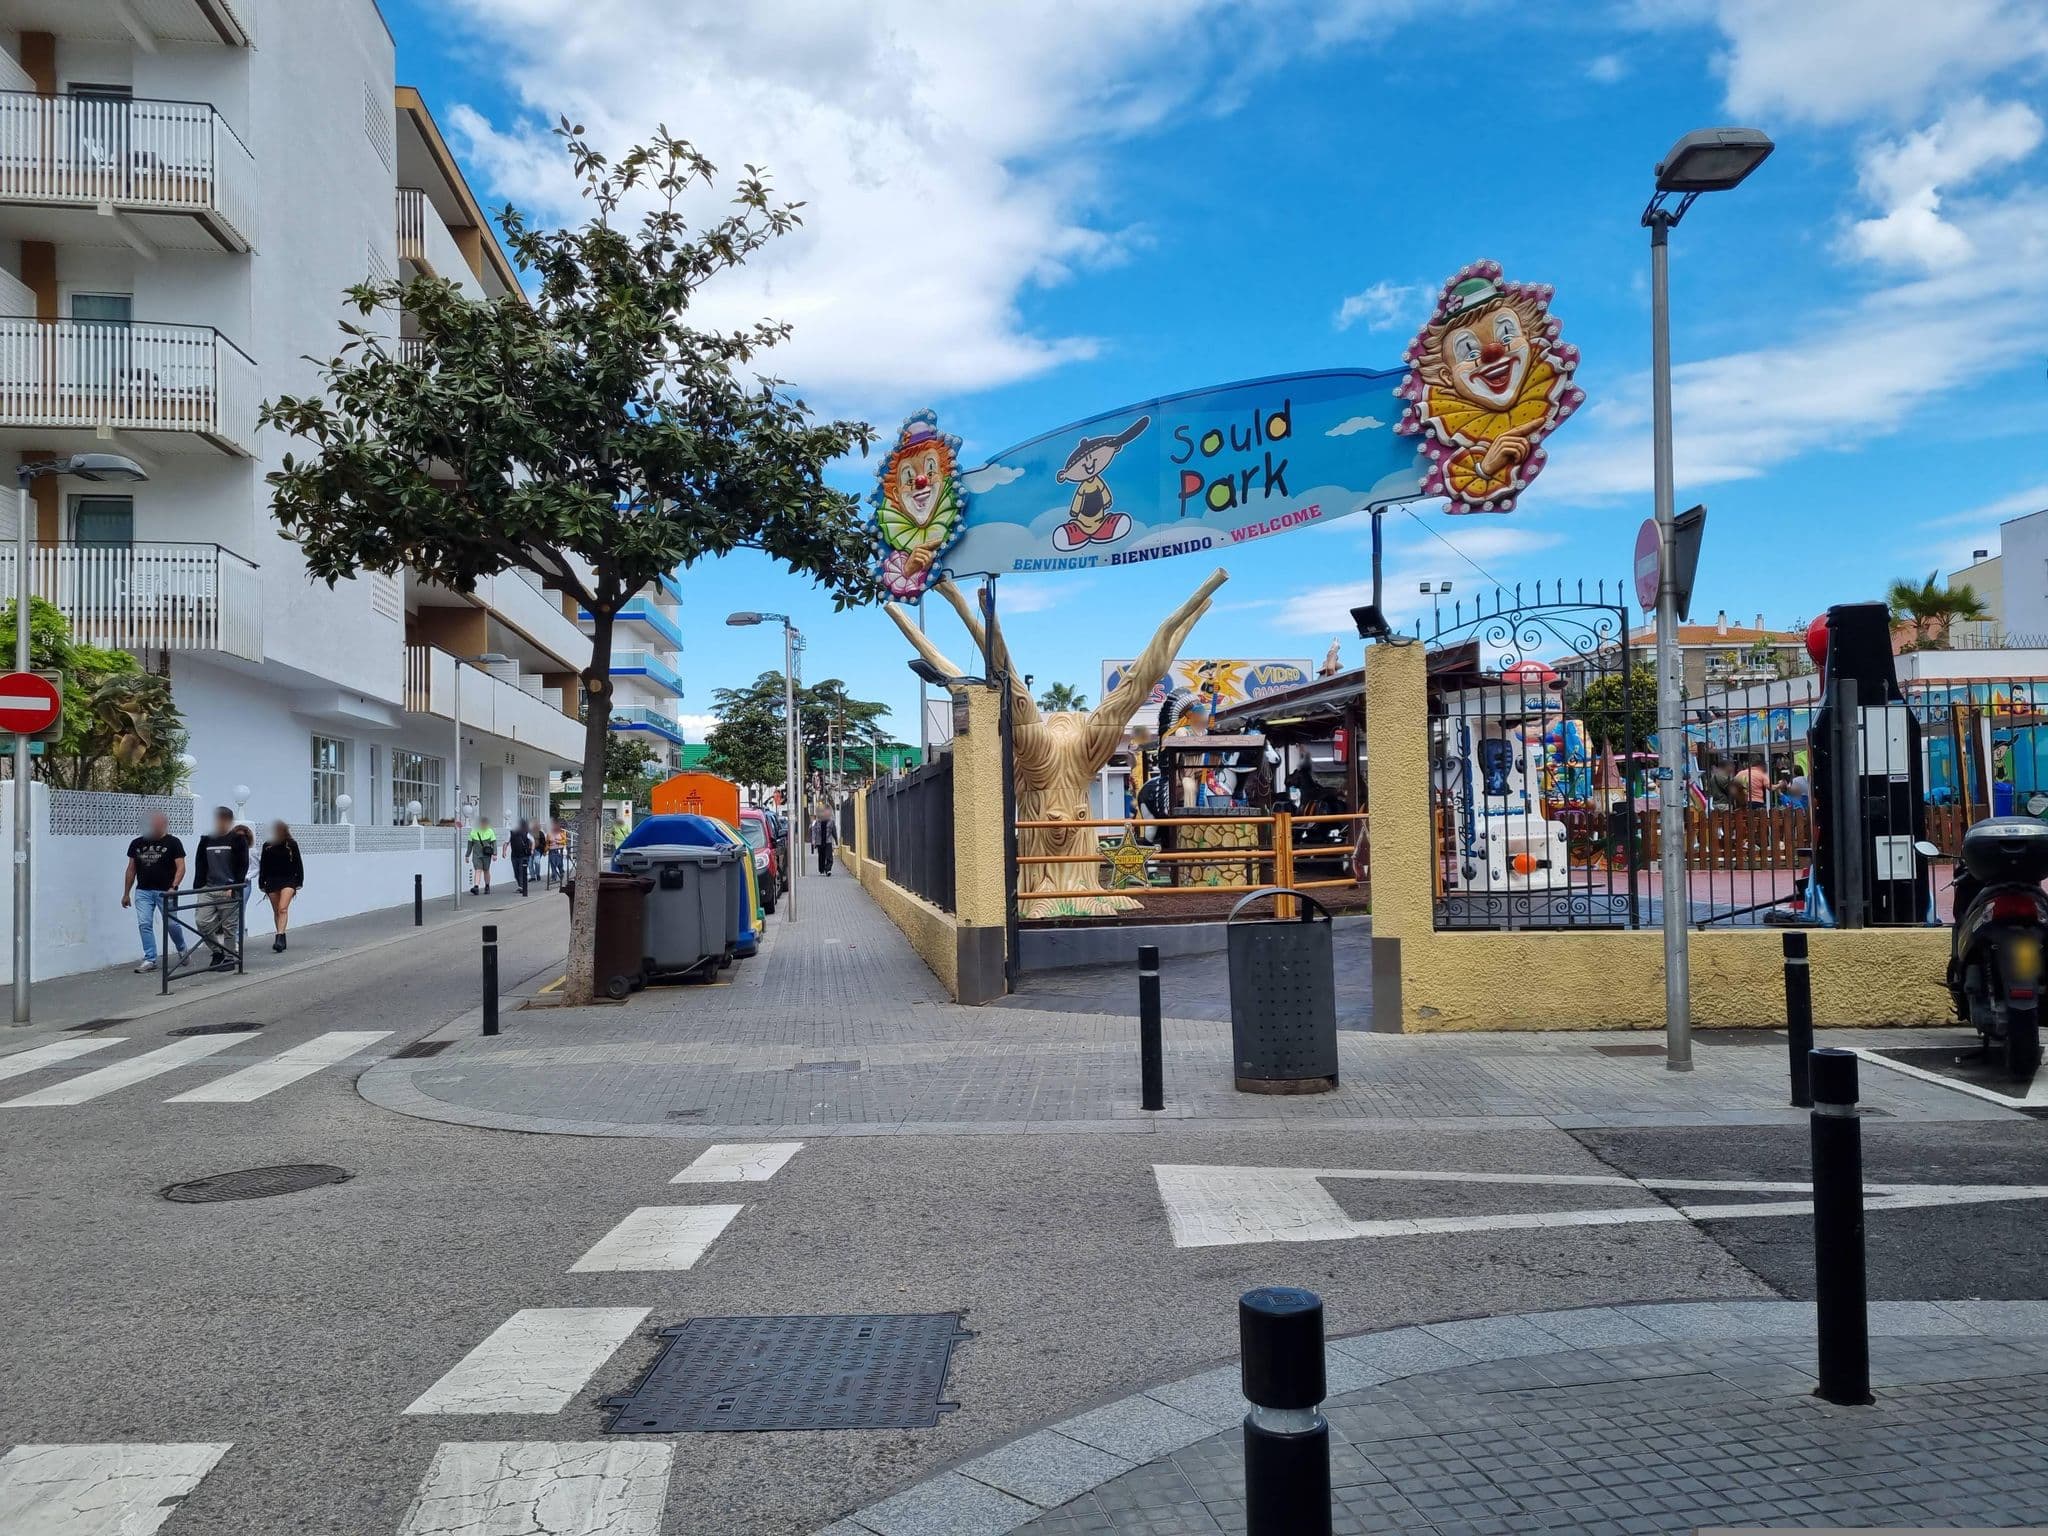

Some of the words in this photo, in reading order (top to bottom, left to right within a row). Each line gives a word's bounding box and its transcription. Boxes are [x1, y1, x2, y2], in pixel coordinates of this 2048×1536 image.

[1170, 398, 1292, 464] Sould
[1177, 451, 1289, 517] Park
[1012, 555, 1099, 571] BENVINGUT
[1110, 535, 1213, 566] BIENVENIDO
[1229, 503, 1323, 543] WELCOME
[1253, 665, 1300, 685] VIDEO
